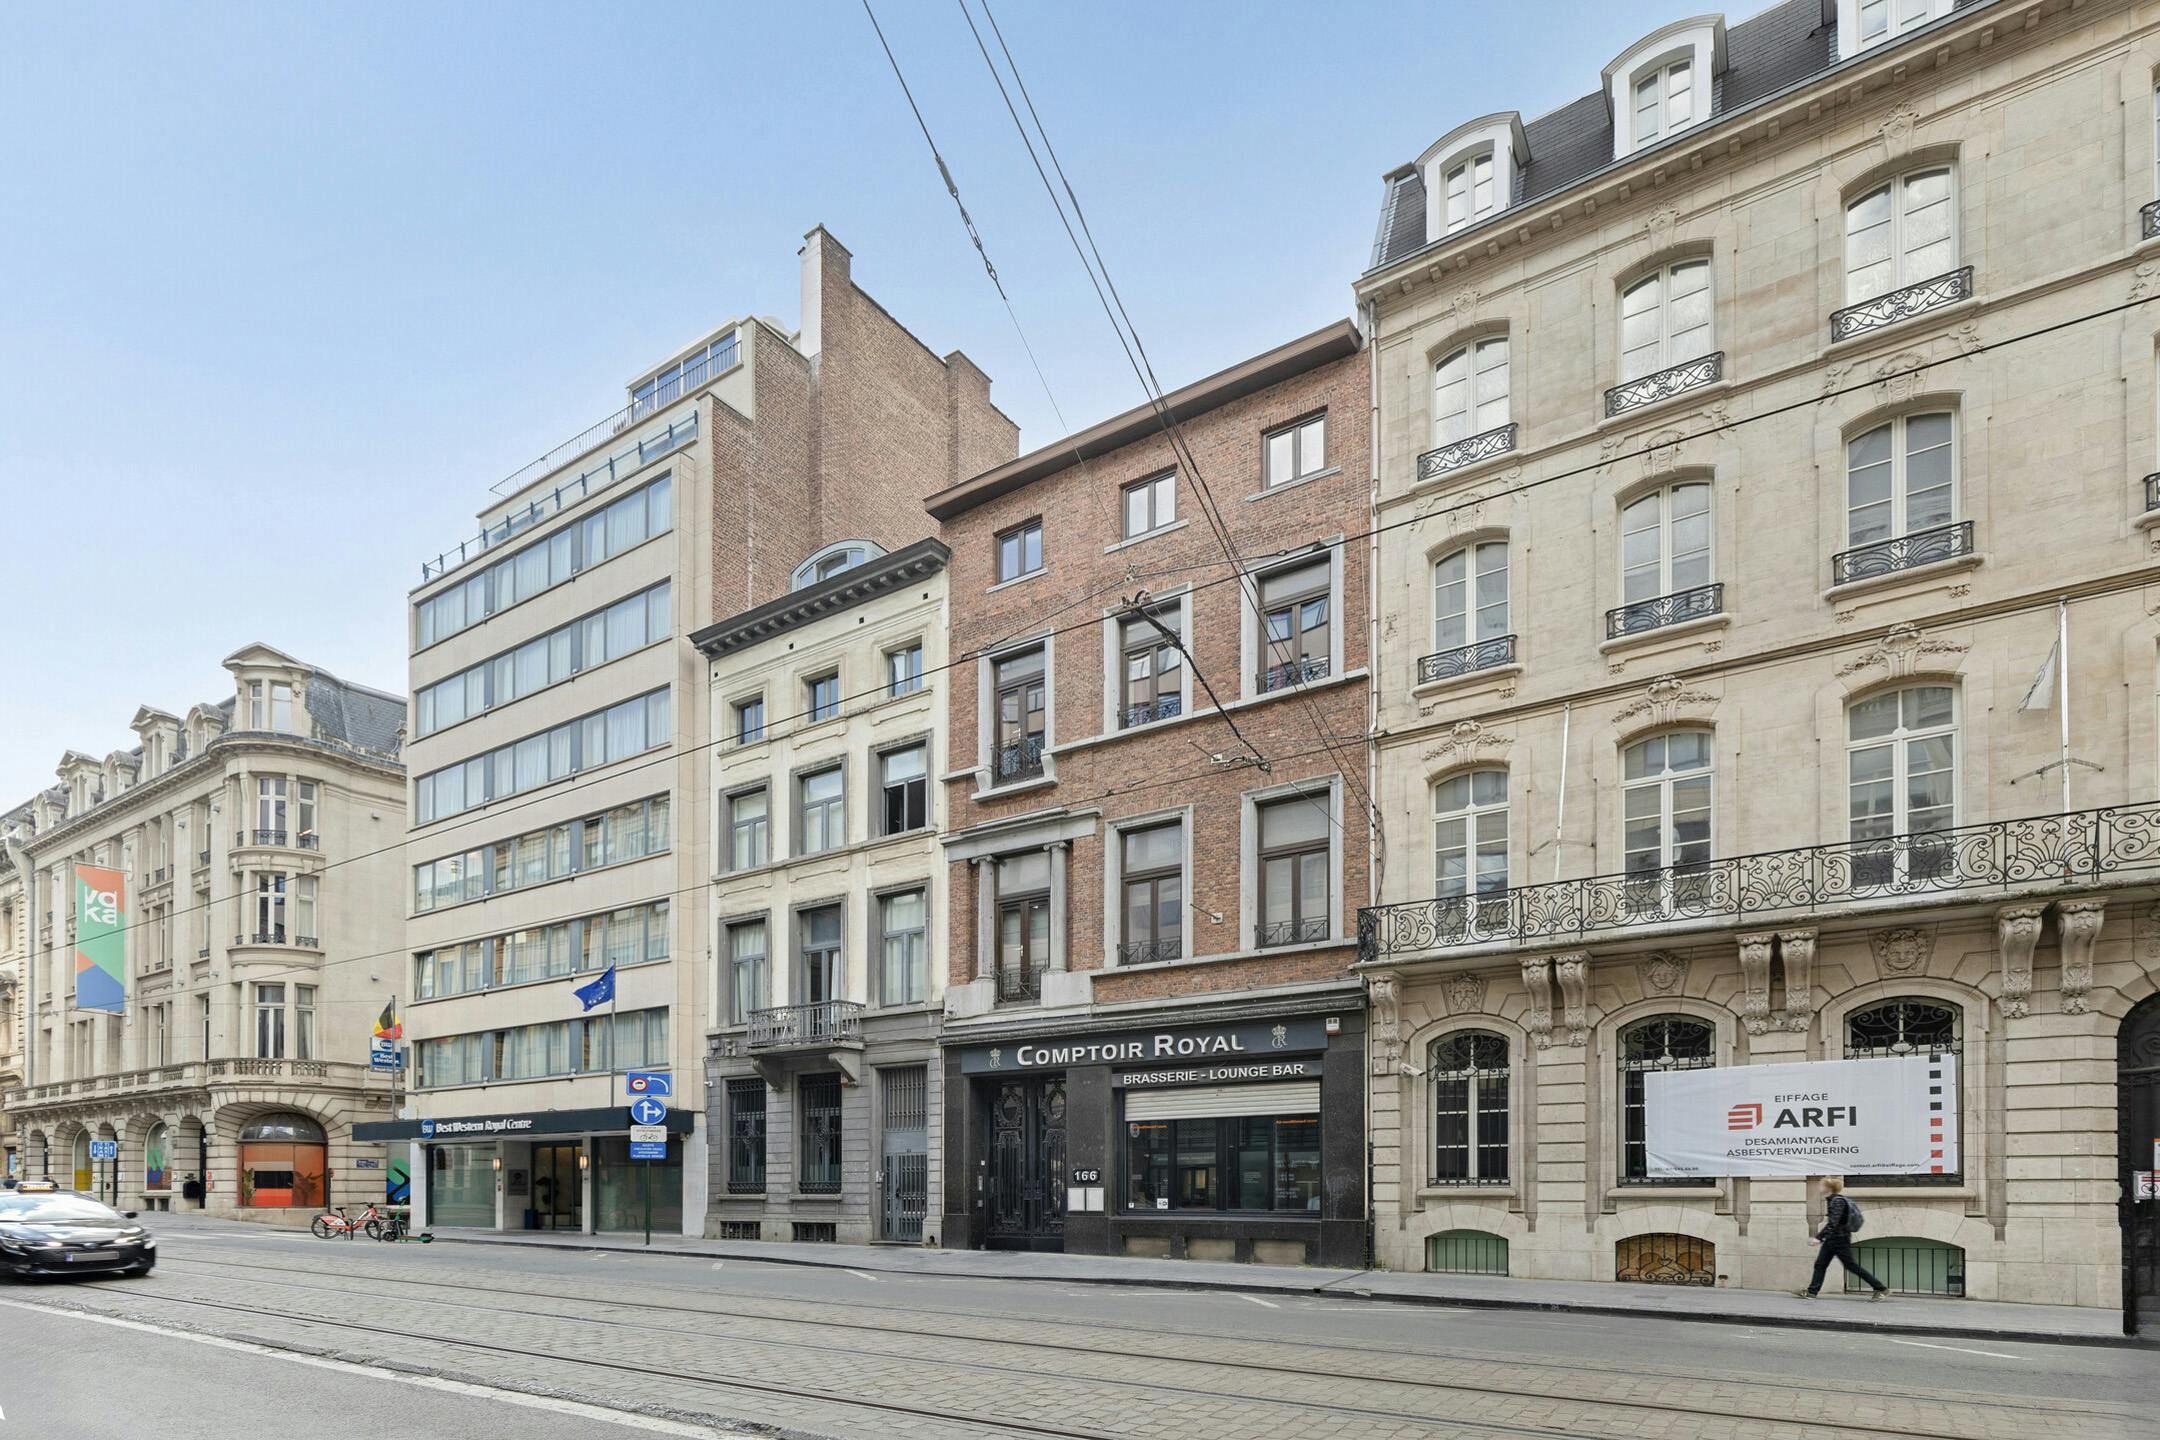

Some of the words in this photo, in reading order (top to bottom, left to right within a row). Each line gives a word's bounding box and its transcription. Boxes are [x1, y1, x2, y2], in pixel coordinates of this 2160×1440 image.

[1016, 1042, 1144, 1066] COMPTOIR
[1154, 1034, 1245, 1057] ROYAL
[373, 1056, 400, 1065] Westen
[1123, 1071, 1198, 1085] BRASSERIE
[1209, 1066, 1268, 1080] LOUNGE
[1272, 1064, 1304, 1077] BAR
[1774, 1093, 1829, 1103] EIFFAGE
[1773, 1106, 1857, 1129] ARFI
[436, 1123, 453, 1133] Best
[453, 1122, 484, 1133] Western
[485, 1120, 506, 1133] Royal
[507, 1119, 532, 1130] Centre
[1745, 1136, 1840, 1146] DESAMIANTAGE
[1726, 1146, 1860, 1157] ASBESTVERWIJDERING
[1074, 1170, 1098, 1181] 166
